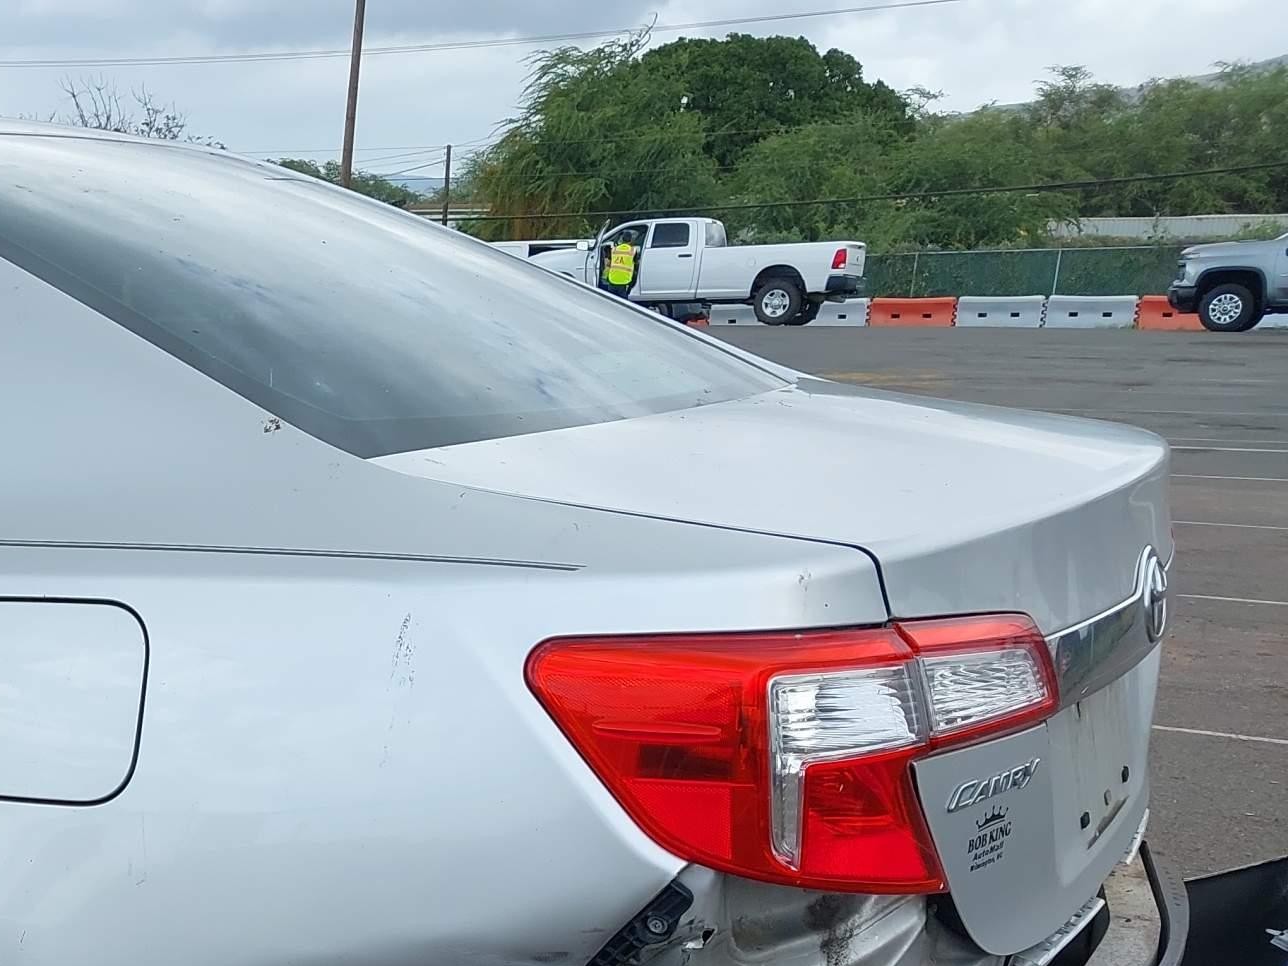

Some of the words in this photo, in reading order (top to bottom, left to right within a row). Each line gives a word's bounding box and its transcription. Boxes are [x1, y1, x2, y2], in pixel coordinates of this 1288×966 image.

[945, 758, 1040, 813] CAMRY
[968, 833, 988, 854] BOB
[989, 821, 1012, 845] KING
